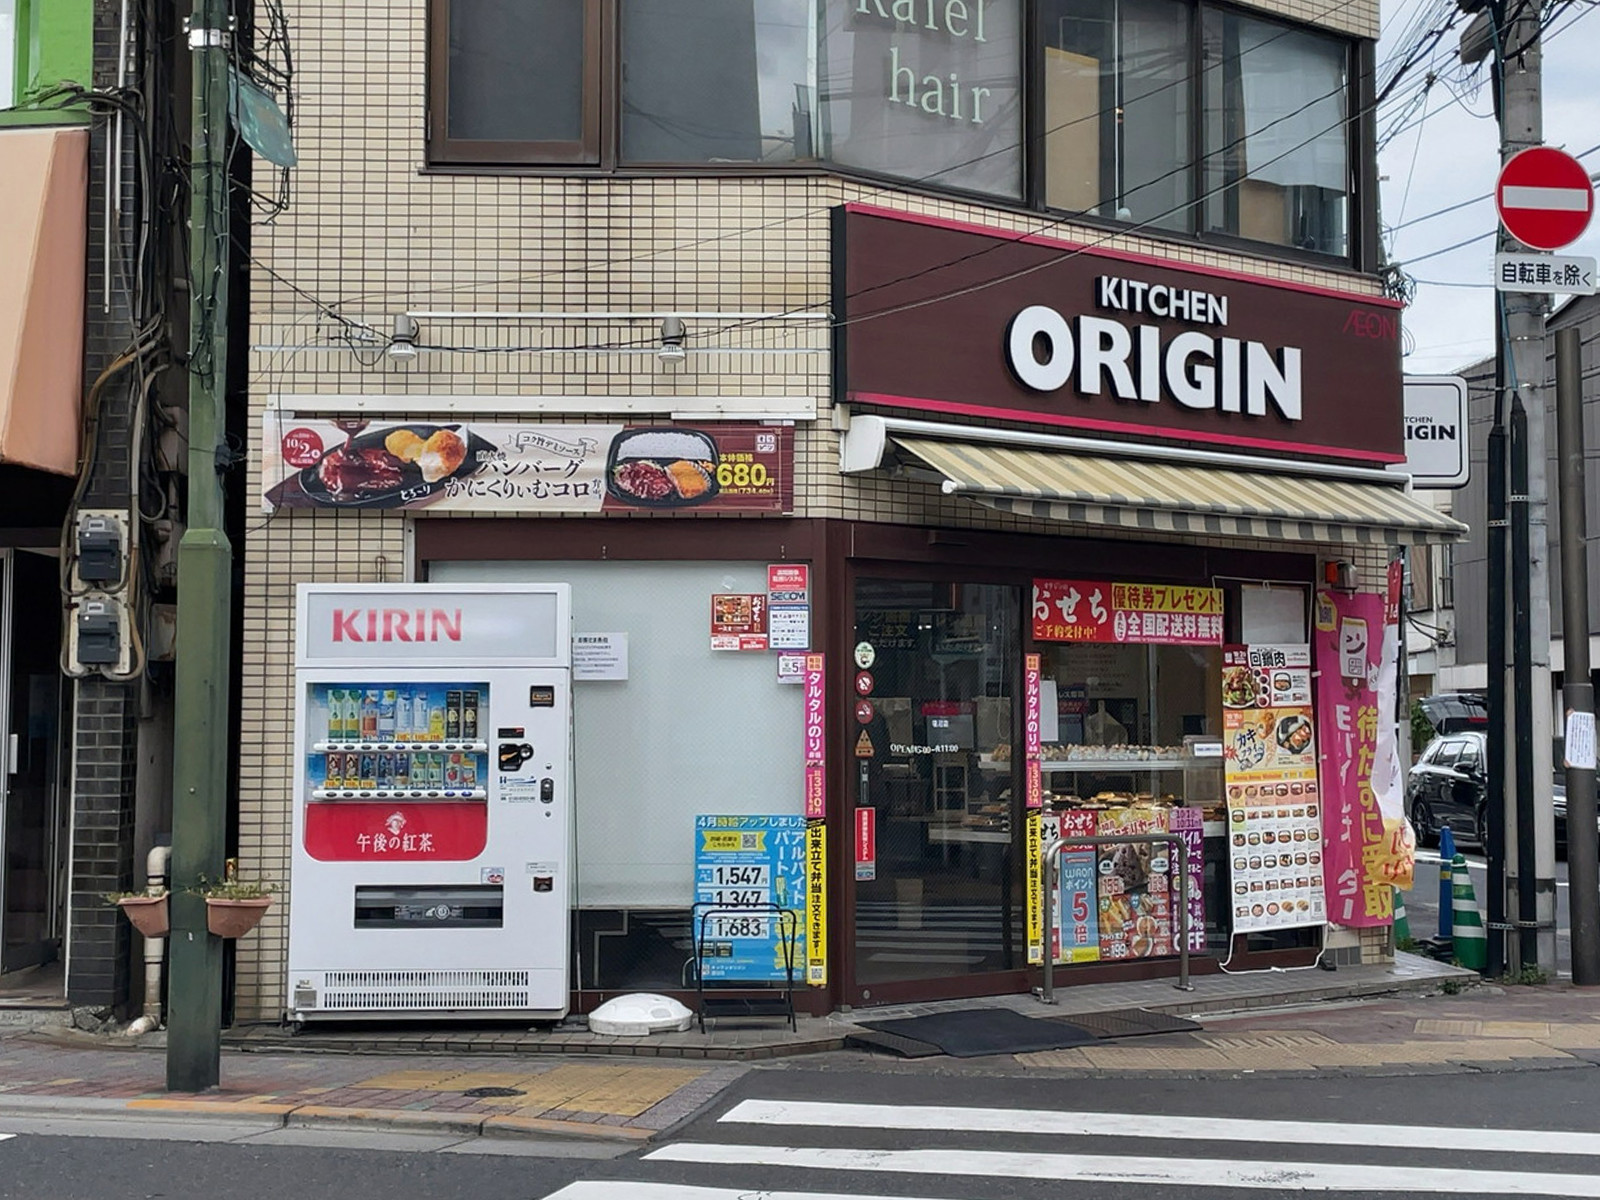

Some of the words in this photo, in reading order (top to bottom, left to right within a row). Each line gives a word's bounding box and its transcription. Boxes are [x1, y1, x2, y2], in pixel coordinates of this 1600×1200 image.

[889, 47, 991, 123] hair
[1502, 262, 1591, 287] 自転車を除く
[1100, 275, 1228, 326] KITCHEN
[1008, 305, 1302, 421] ORIGIN
[477, 459, 585, 479] ハンバーグ
[770, 592, 805, 601] SECOM
[1033, 584, 1108, 624] おせち
[331, 608, 463, 642] KIRIN
[1127, 611, 1224, 639] 全国配送料無料
[1064, 813, 1093, 829] おせち
[356, 833, 433, 852] 午後の紅茶
[774, 831, 790, 876] パート
[1066, 880, 1093, 890] ポイント
